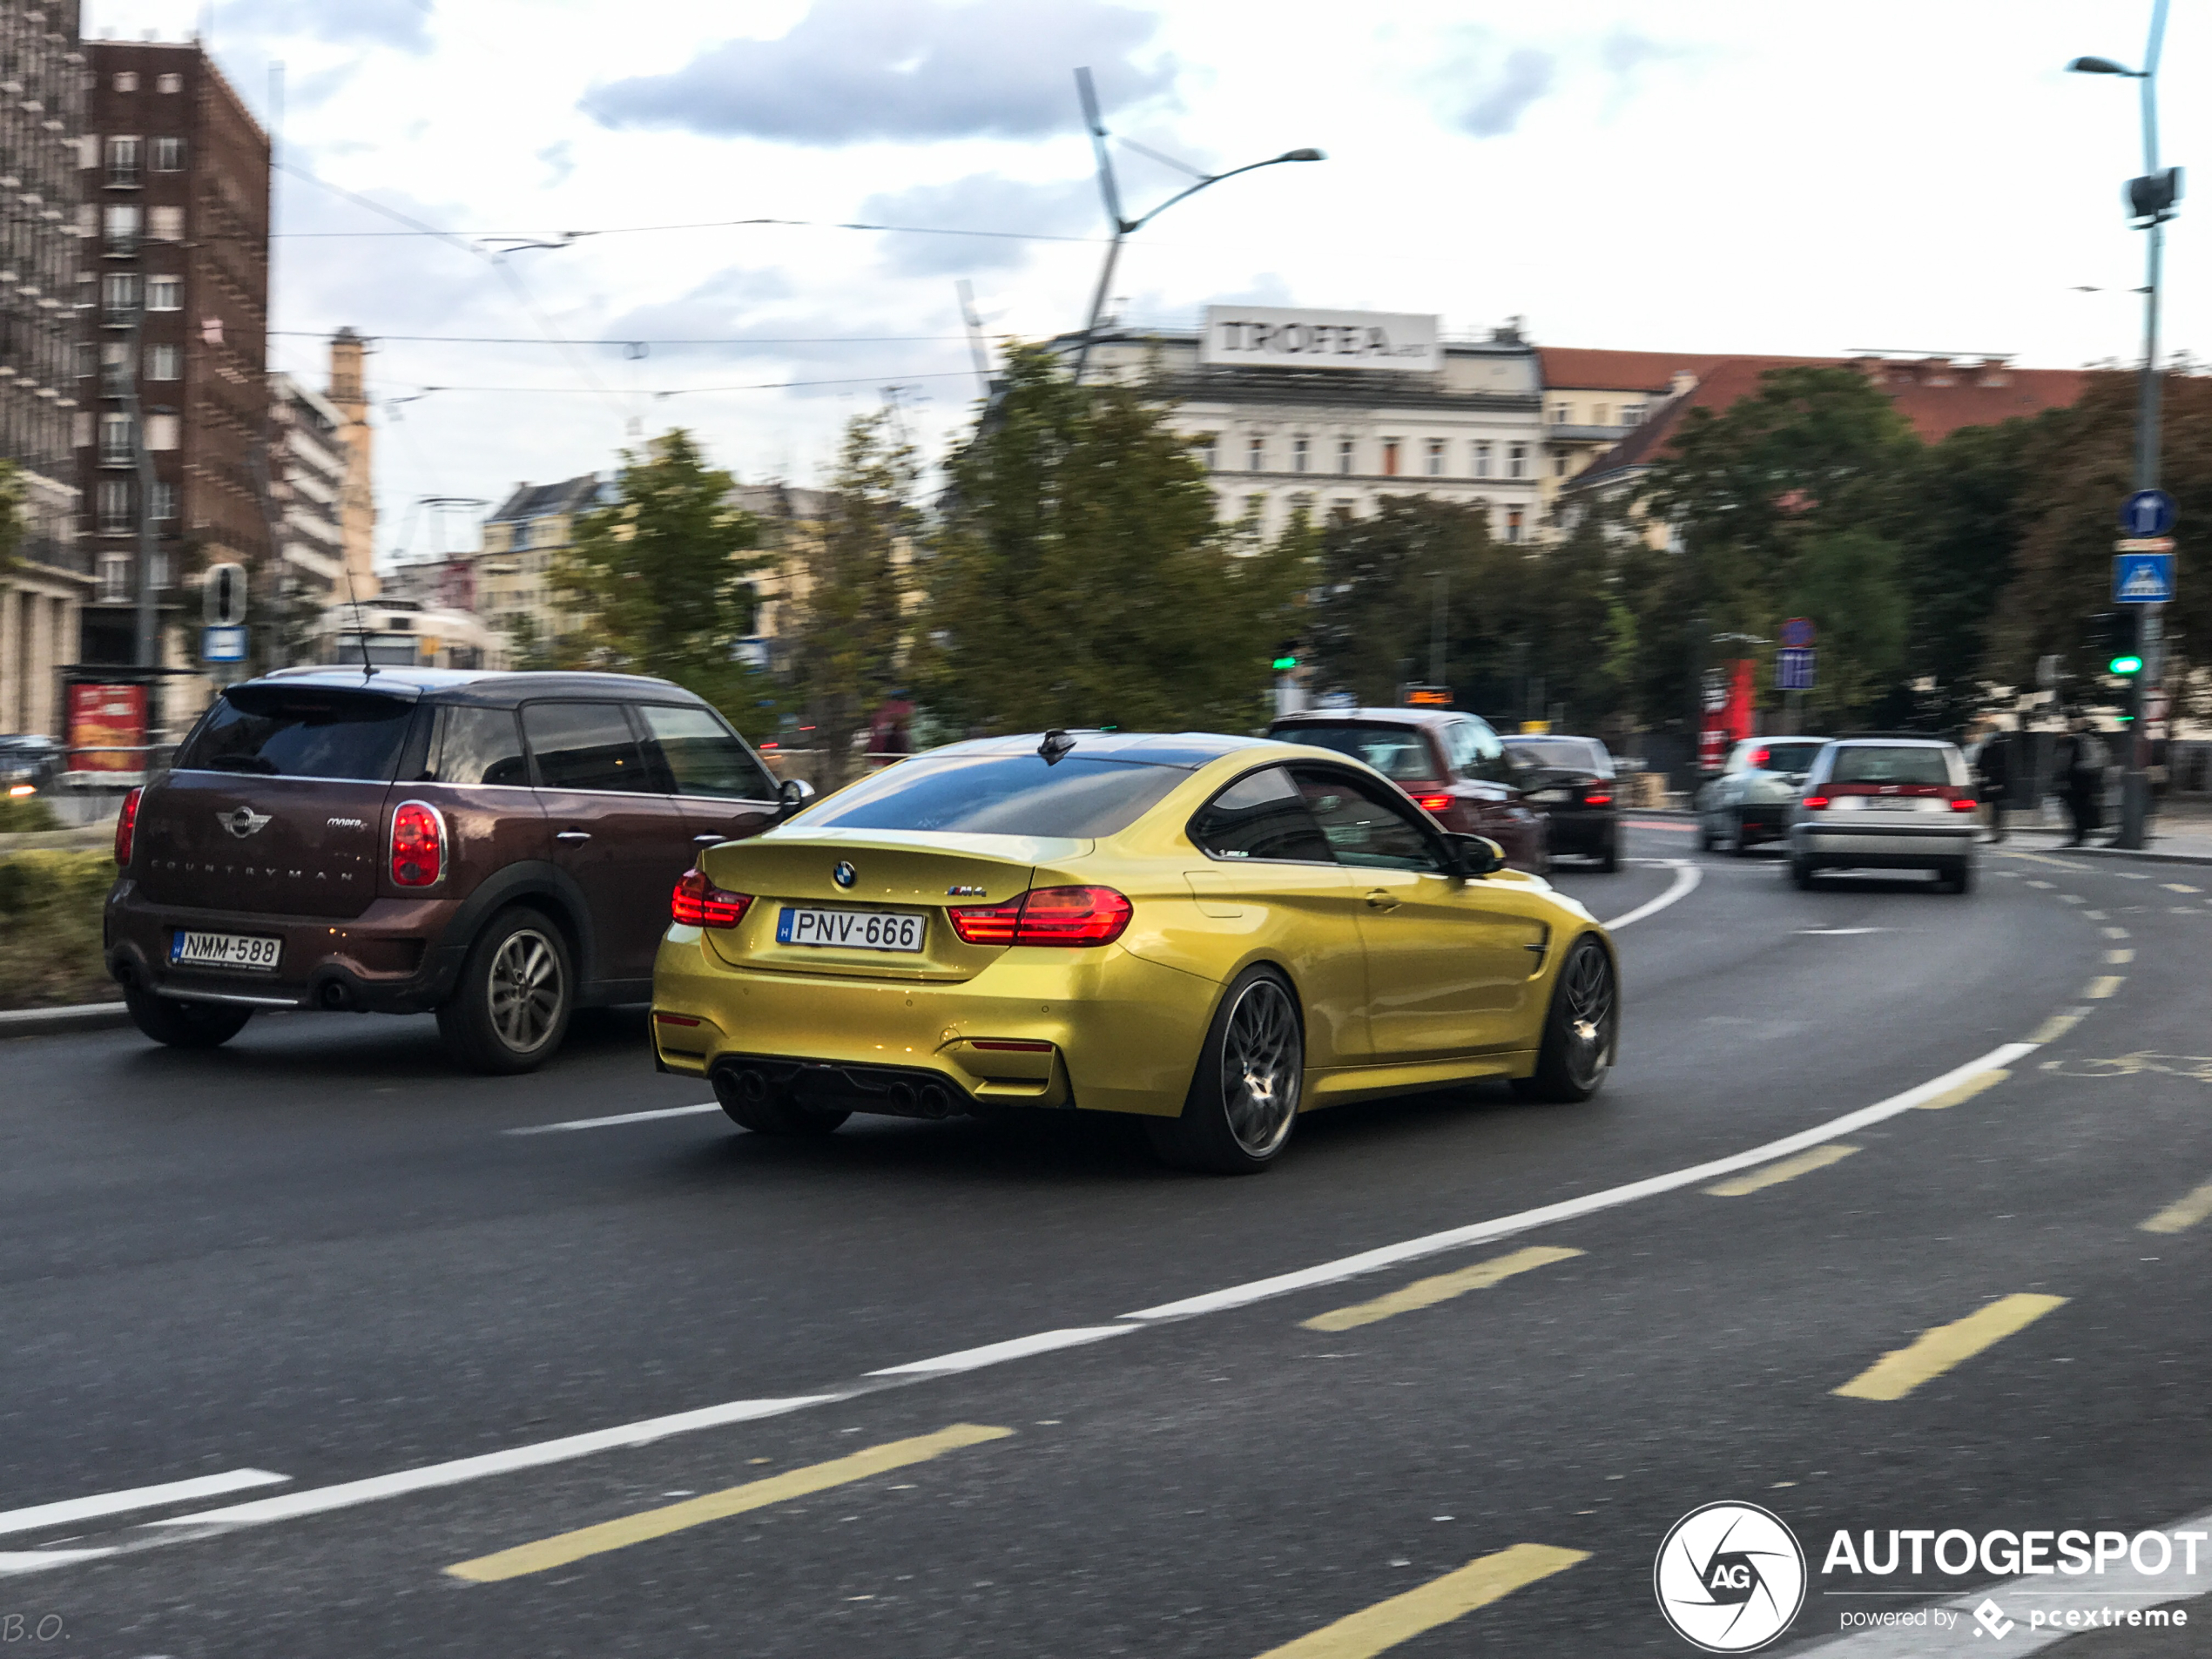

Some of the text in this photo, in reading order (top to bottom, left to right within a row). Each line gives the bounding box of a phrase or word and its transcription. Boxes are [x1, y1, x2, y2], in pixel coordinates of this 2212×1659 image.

[1217, 320, 1391, 359] TROFEA
[151, 860, 353, 881] COUNTRYMAN
[780, 913, 915, 947] H PNV-666
[185, 934, 275, 963] NMM-588
